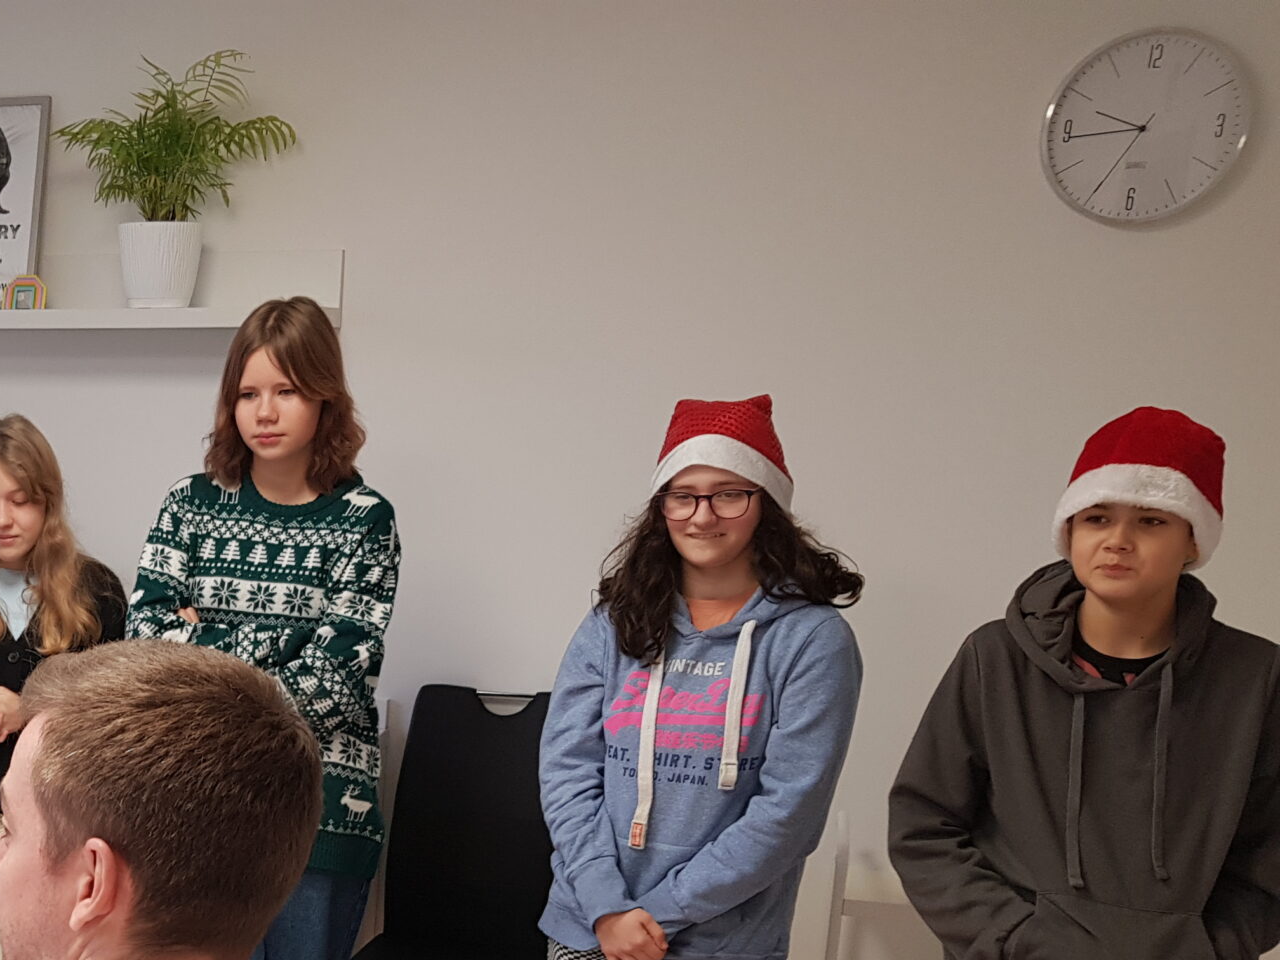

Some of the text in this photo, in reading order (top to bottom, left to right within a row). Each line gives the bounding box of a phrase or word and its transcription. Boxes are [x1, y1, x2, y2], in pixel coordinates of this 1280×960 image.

[1147, 43, 1164, 69] 12
[1062, 119, 1073, 143] 9
[1214, 113, 1226, 138] 3
[1125, 187, 1136, 211] 6
[667, 773, 713, 786] JAPAN.
